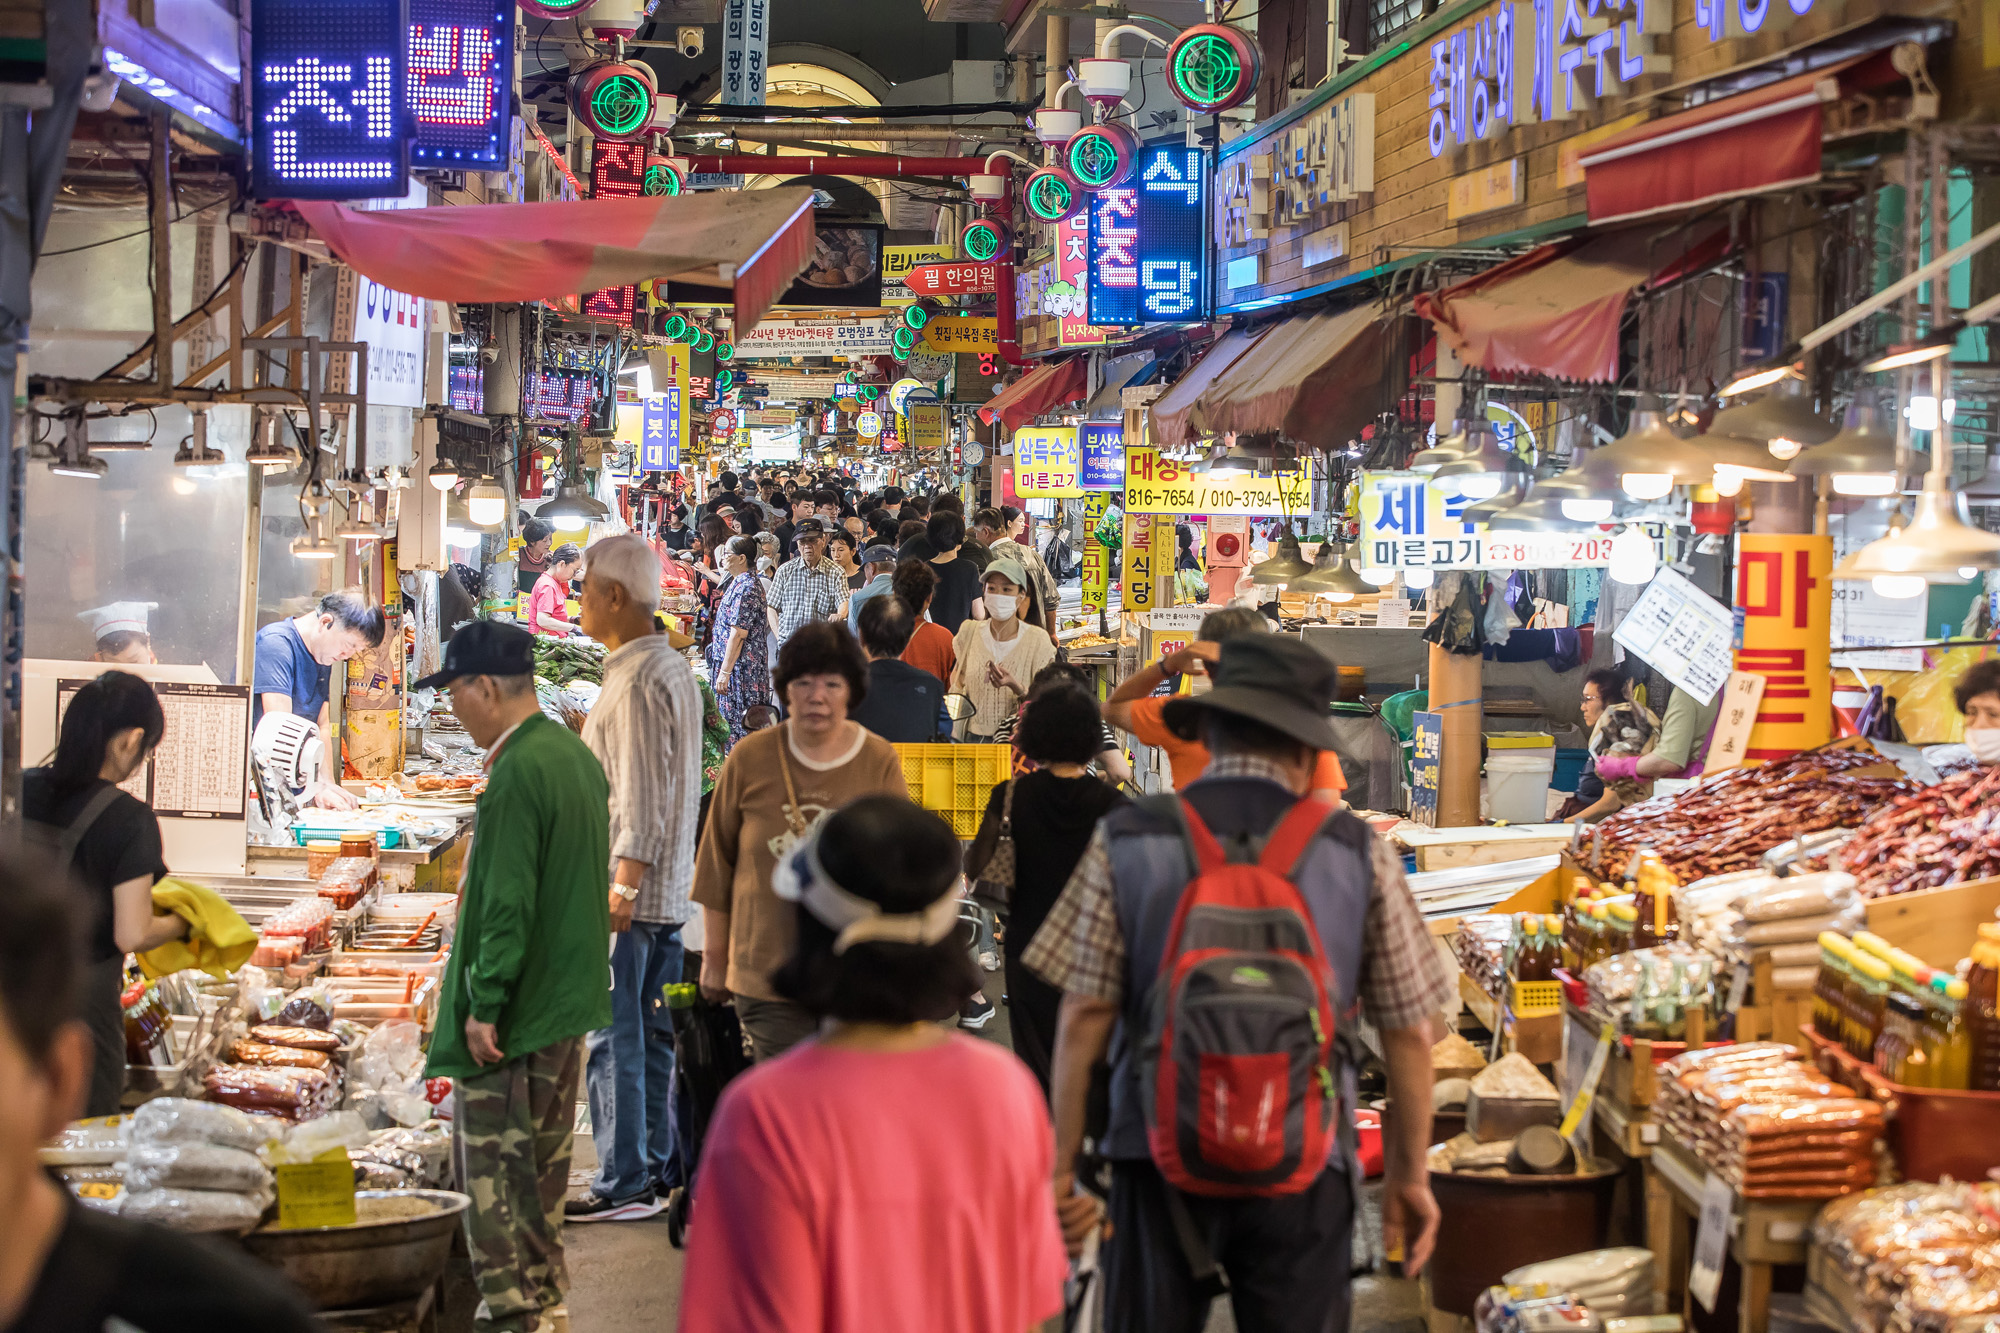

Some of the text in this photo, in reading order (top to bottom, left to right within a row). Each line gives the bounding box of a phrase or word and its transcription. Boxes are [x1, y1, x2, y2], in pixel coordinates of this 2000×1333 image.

[727, 50, 743, 93] 광장
[748, 50, 763, 94] 광장
[265, 57, 392, 178] 전
[924, 269, 940, 289] 필
[945, 266, 996, 288] 한의원
[743, 327, 774, 341] 024년
[777, 326, 835, 341] 부전마켓타운
[838, 325, 875, 339] 모범점포
[1065, 323, 1099, 338] 식자재
[669, 391, 679, 466] 전봇대
[1018, 437, 1077, 465] 삼득수산
[1021, 472, 1079, 490] 마른고기
[1128, 488, 1194, 508] 816-7654
[1210, 490, 1310, 509] 010-3794-7654
[1375, 539, 1481, 566] 마른고기
[1153, 612, 1164, 620] 골목
